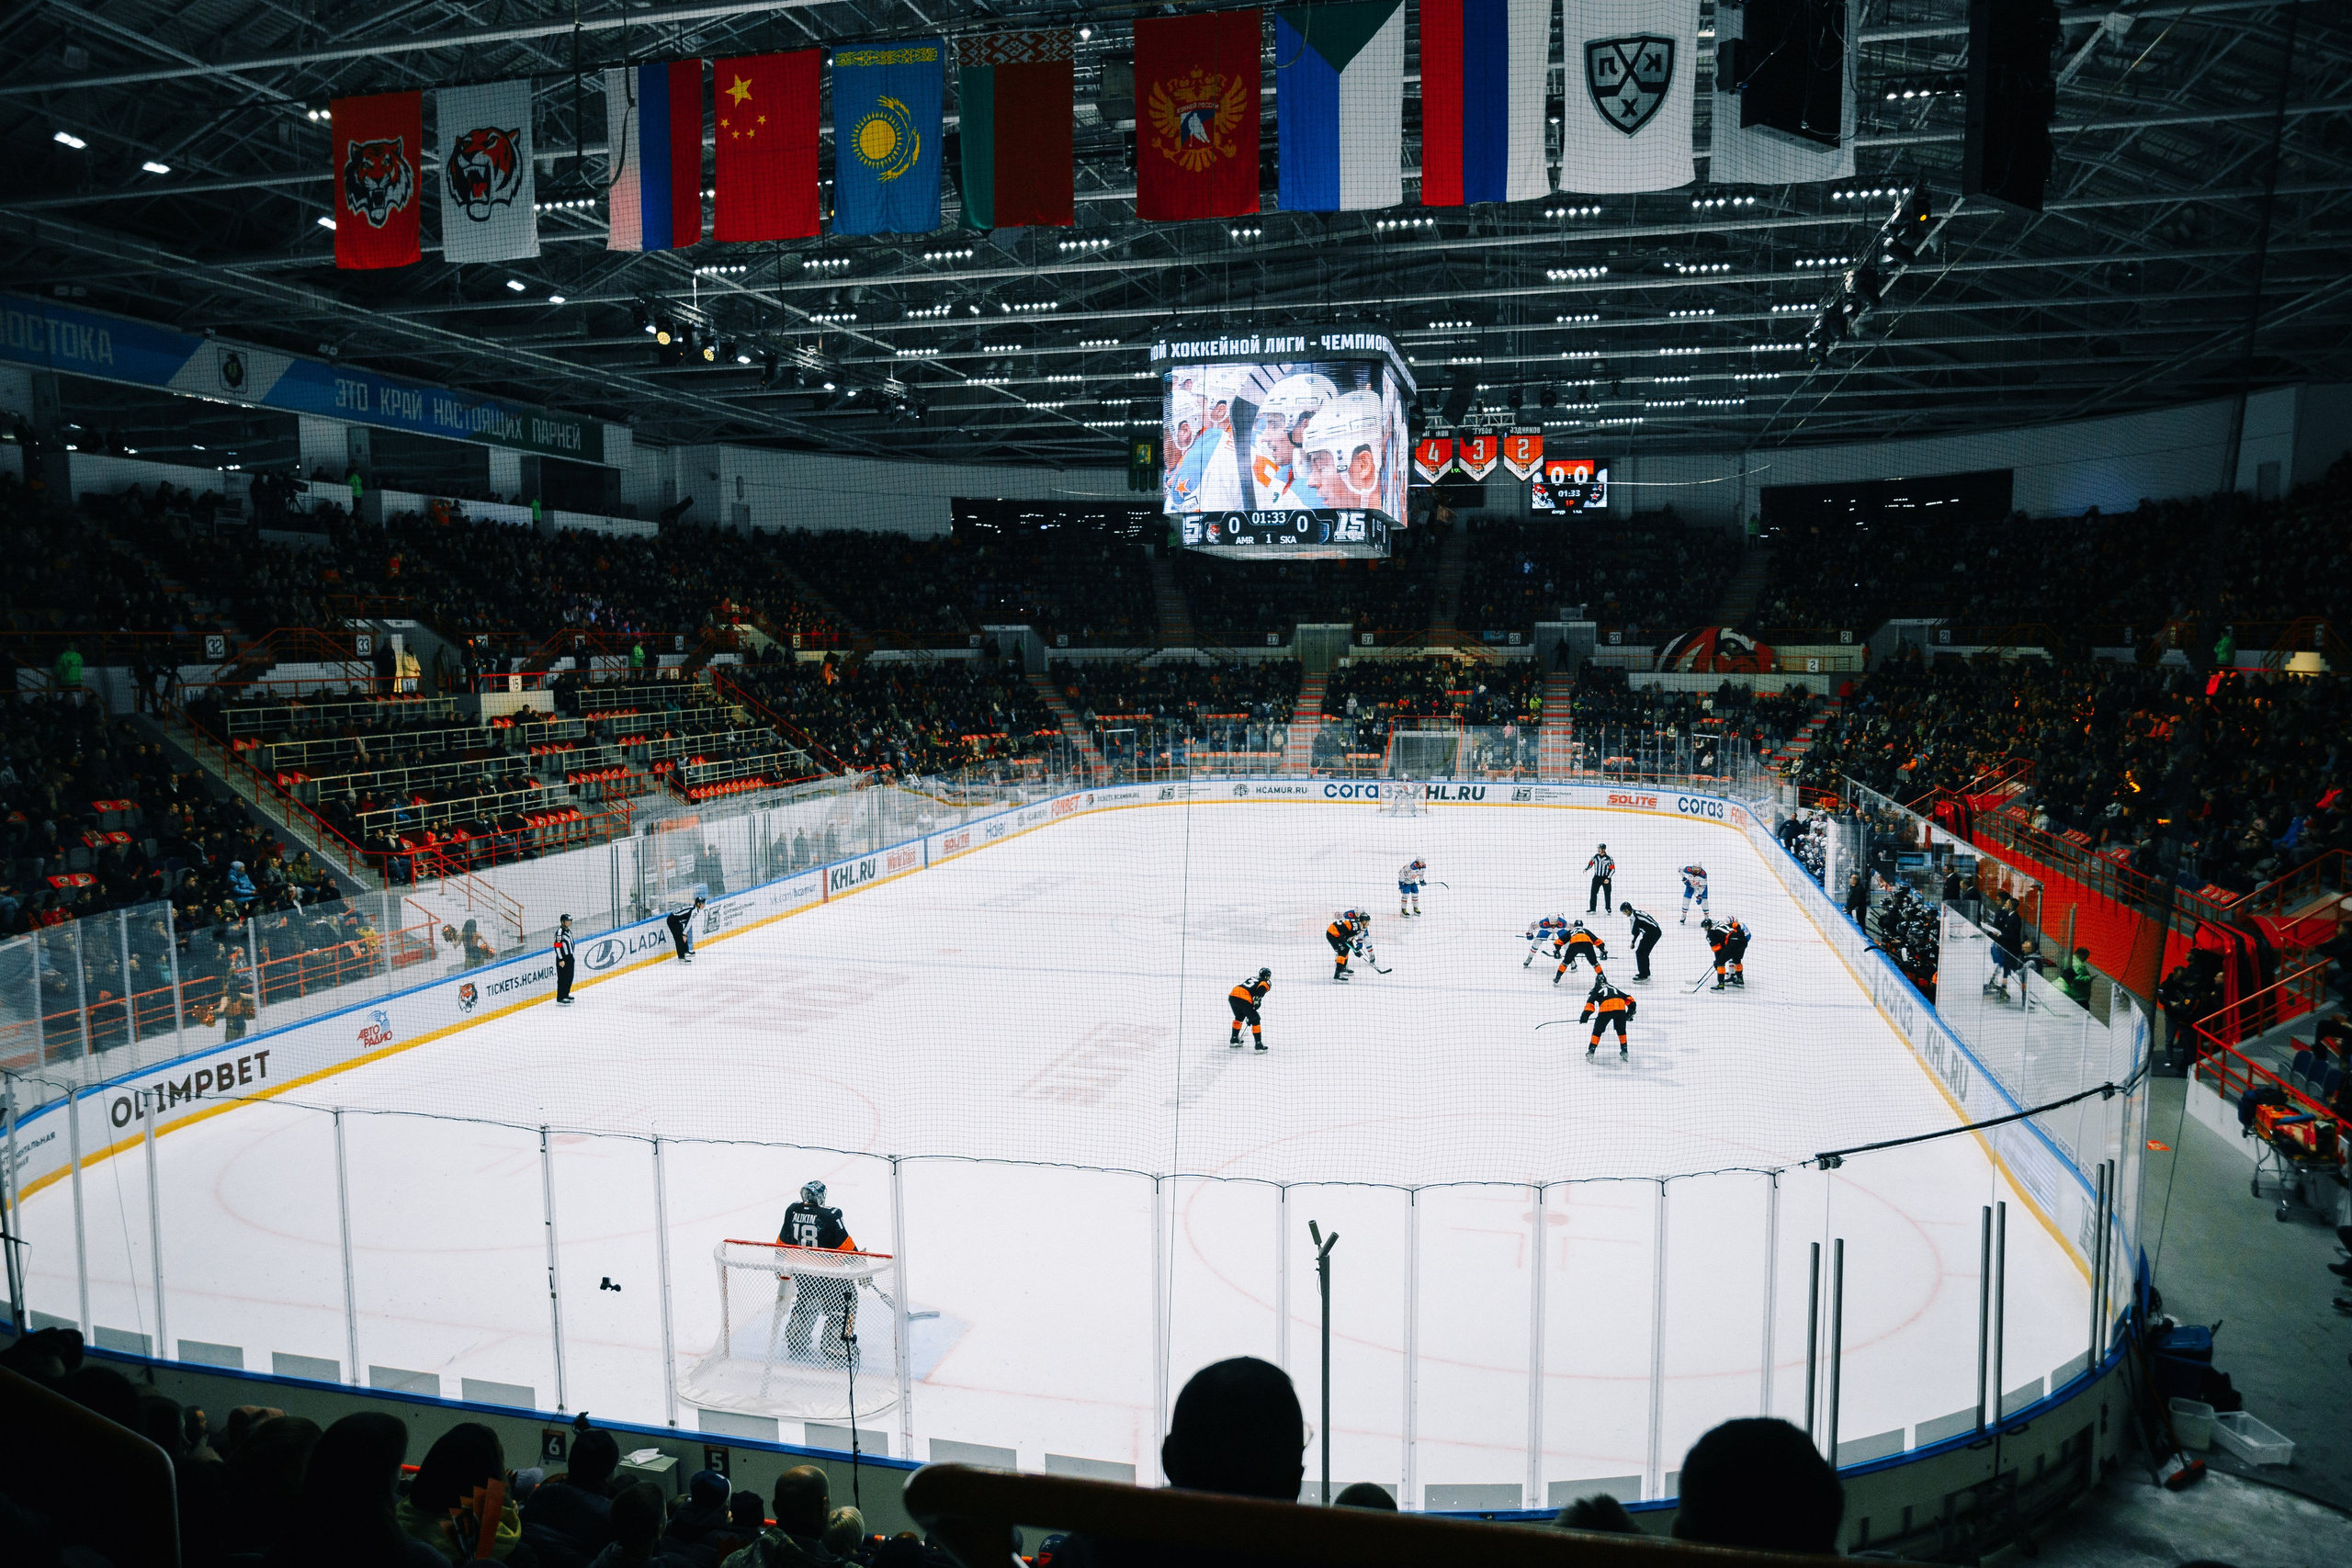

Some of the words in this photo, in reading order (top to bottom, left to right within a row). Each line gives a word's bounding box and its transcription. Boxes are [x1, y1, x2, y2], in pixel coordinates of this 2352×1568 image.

[1170, 335, 1260, 357] ХОККЕЙНОЙ
[1264, 336, 1305, 353] ЛИГИ
[334, 378, 368, 412] ЭТО
[379, 386, 423, 422] КРАЙ
[434, 397, 524, 441] НАСТОЯЩИХ
[532, 417, 582, 451] ПАРНЕЙ
[1428, 442, 1439, 462] 4
[1473, 439, 1484, 459] 3
[1518, 439, 1529, 459] 2
[1558, 490, 1580, 498] 01:33
[1228, 517, 1240, 534] 0
[1251, 512, 1286, 525] 01:33
[1296, 515, 1308, 533] 0
[1236, 536, 1254, 545] AMR
[1266, 534, 1272, 544] 1
[1280, 536, 1296, 544] SKA
[1268, 635, 1278, 644] 37
[1363, 635, 1373, 644] 37
[1510, 634, 1520, 643] 20
[1610, 633, 1621, 642] 20
[1841, 632, 1851, 643] 21
[1940, 631, 1950, 642] 21
[208, 638, 222, 655] 32
[358, 638, 369, 653] 33
[1810, 660, 1815, 670] 2
[512, 678, 519, 689] 15
[1256, 786, 1307, 795] HCAMUR.RU
[1051, 795, 1080, 818] FONBET
[1609, 795, 1657, 806] SOLITE
[831, 858, 876, 892] KHL.RU
[629, 929, 666, 954] LADA
[486, 966, 556, 997] TICKETS.HCAMUR.
[356, 1024, 379, 1041] АВТО
[364, 1030, 392, 1048] РАДИО
[1925, 1020, 1969, 1102] KHL.RU
[111, 1050, 270, 1128] OLIMPBET
[793, 1223, 818, 1247] 18
[548, 1436, 560, 1455] 6
[711, 1451, 724, 1472] 5
